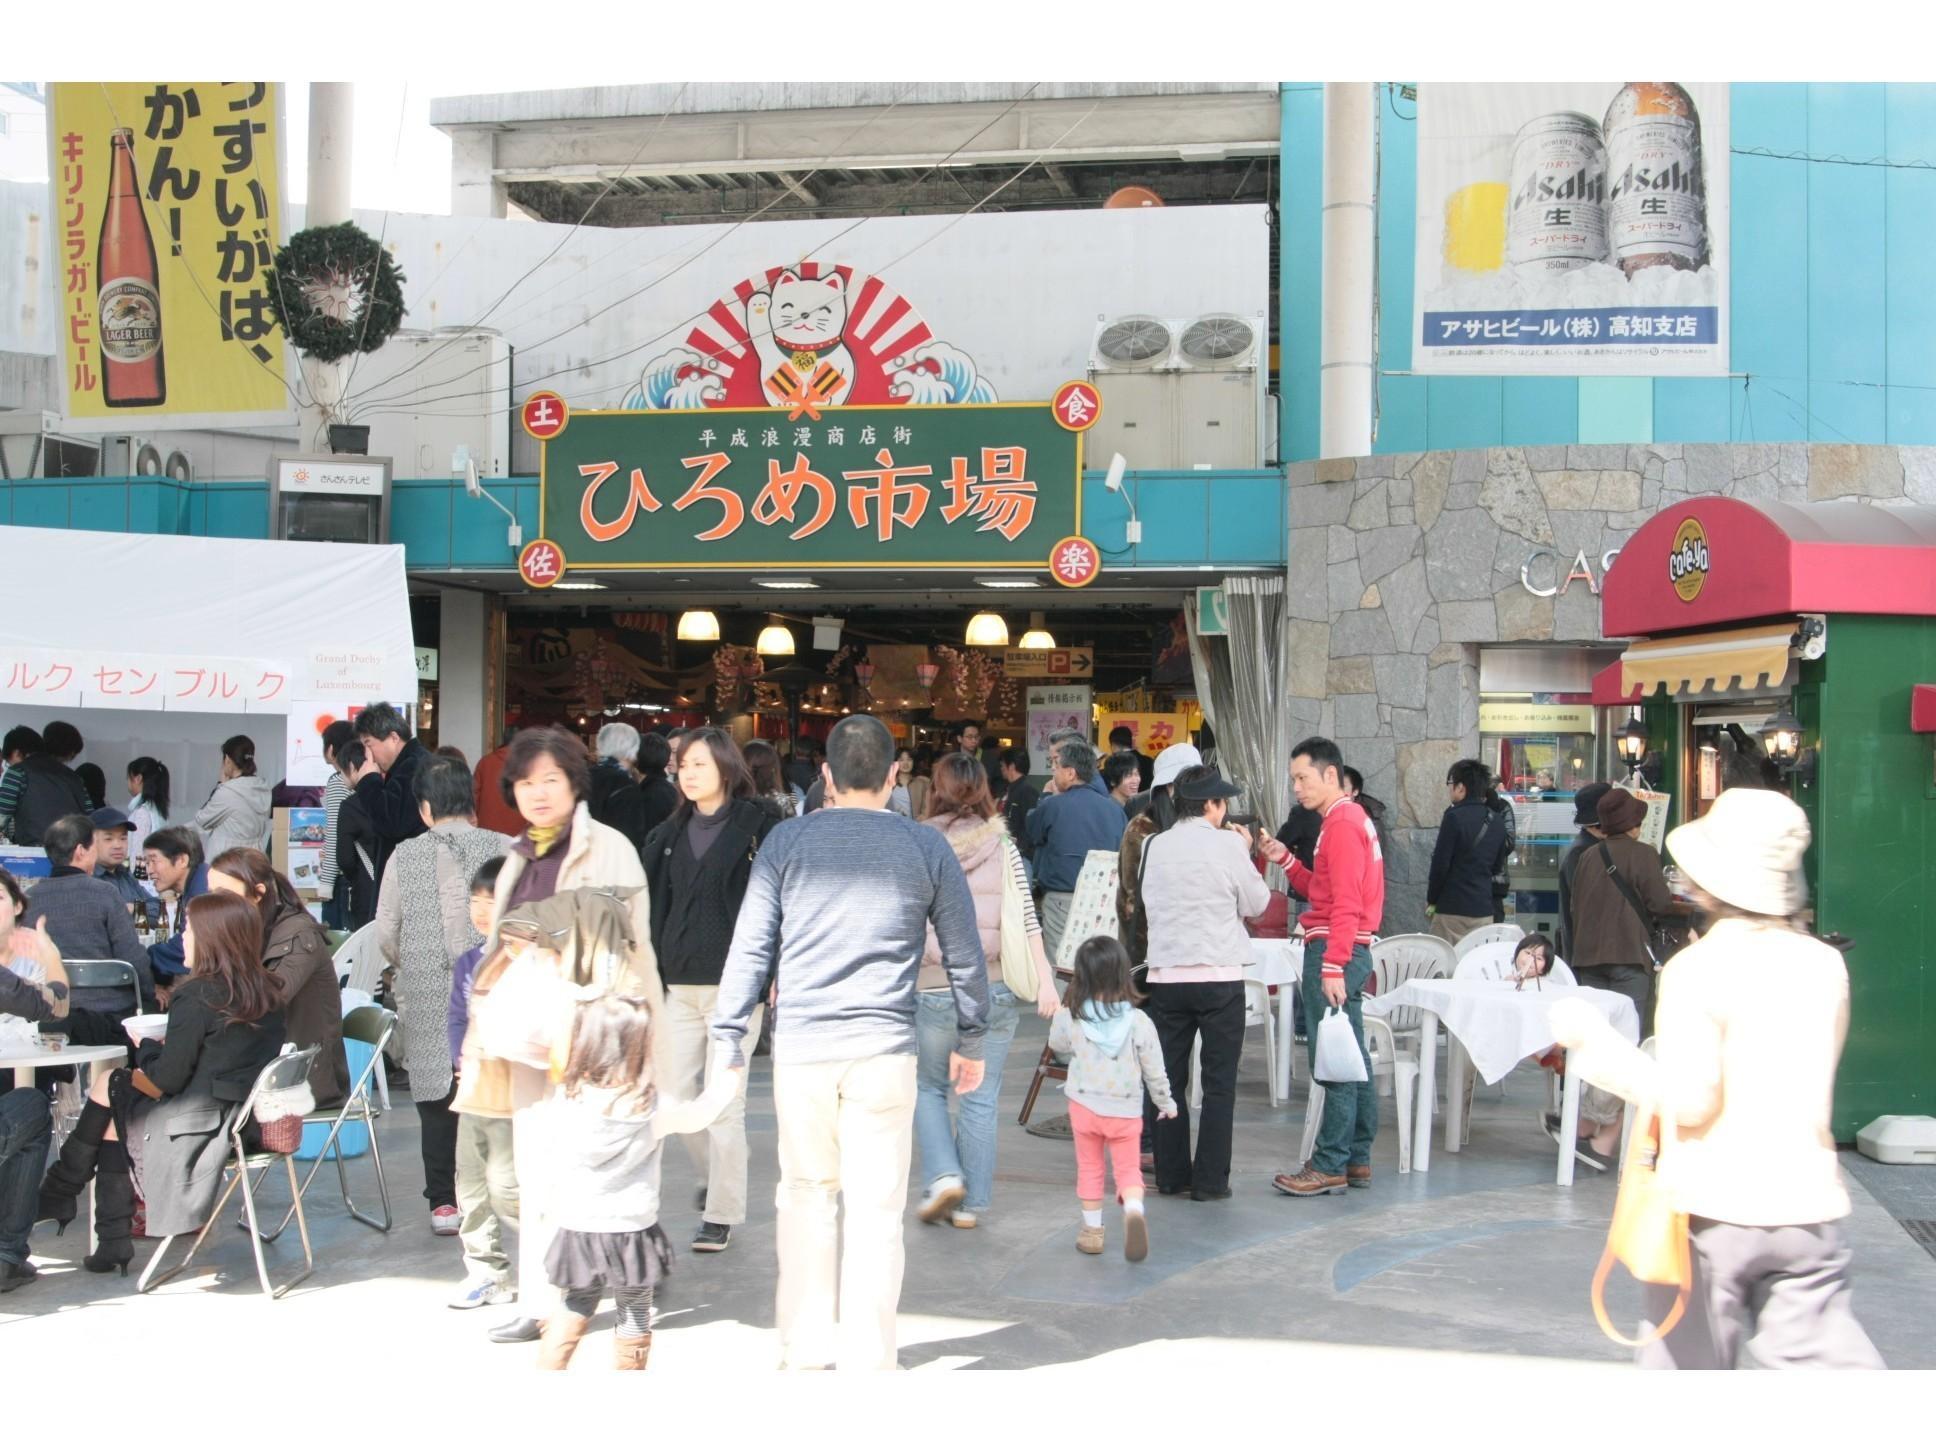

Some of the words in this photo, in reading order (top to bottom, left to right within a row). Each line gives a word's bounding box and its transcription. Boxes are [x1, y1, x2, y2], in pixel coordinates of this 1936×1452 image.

[1514, 168, 1604, 211] Asahi
[1640, 197, 1668, 215] 生
[1544, 208, 1572, 227] 生
[1530, 233, 1588, 246] スーパードライ
[62, 132, 97, 392] キリンラガービール
[106, 329, 132, 341] LAGER
[133, 328, 154, 339] BEER
[1608, 315, 1698, 337] 高知支店
[529, 399, 560, 428] 土
[1059, 387, 1096, 424] 食
[698, 425, 913, 449] 平成浪漫商店街
[320, 474, 372, 486] さんさんテレビ
[577, 445, 1039, 544] ひろめ市場
[523, 546, 558, 578] 佐
[1058, 544, 1093, 578] 楽
[315, 653, 347, 664] Grand
[350, 653, 381, 665] Duchy
[1051, 653, 1067, 671] P
[337, 665, 348, 676] of
[315, 679, 382, 691] Luxembourg
